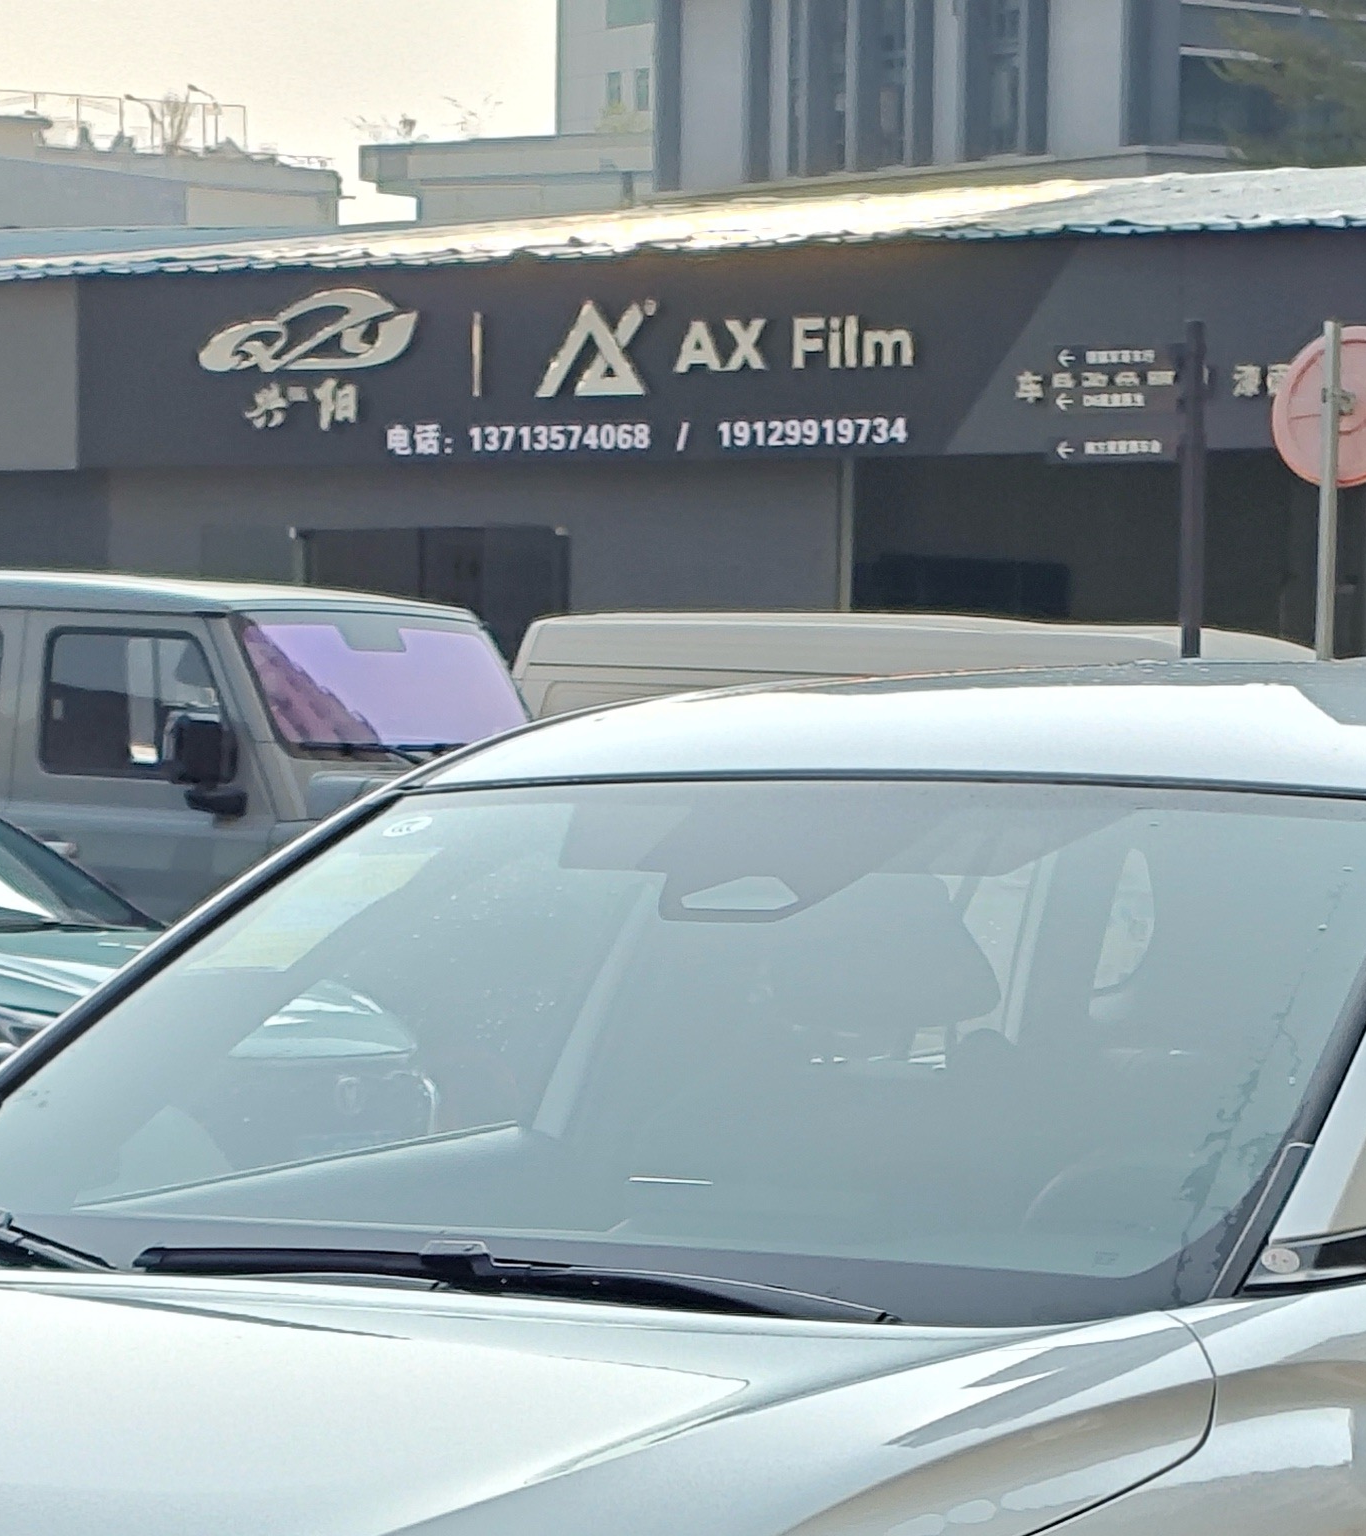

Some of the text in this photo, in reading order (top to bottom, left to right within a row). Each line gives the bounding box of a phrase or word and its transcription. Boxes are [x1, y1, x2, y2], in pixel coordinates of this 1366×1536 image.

[673, 314, 915, 373] AX Film
[469, 423, 651, 452] 13713574068
[718, 417, 908, 447] 19129919734
